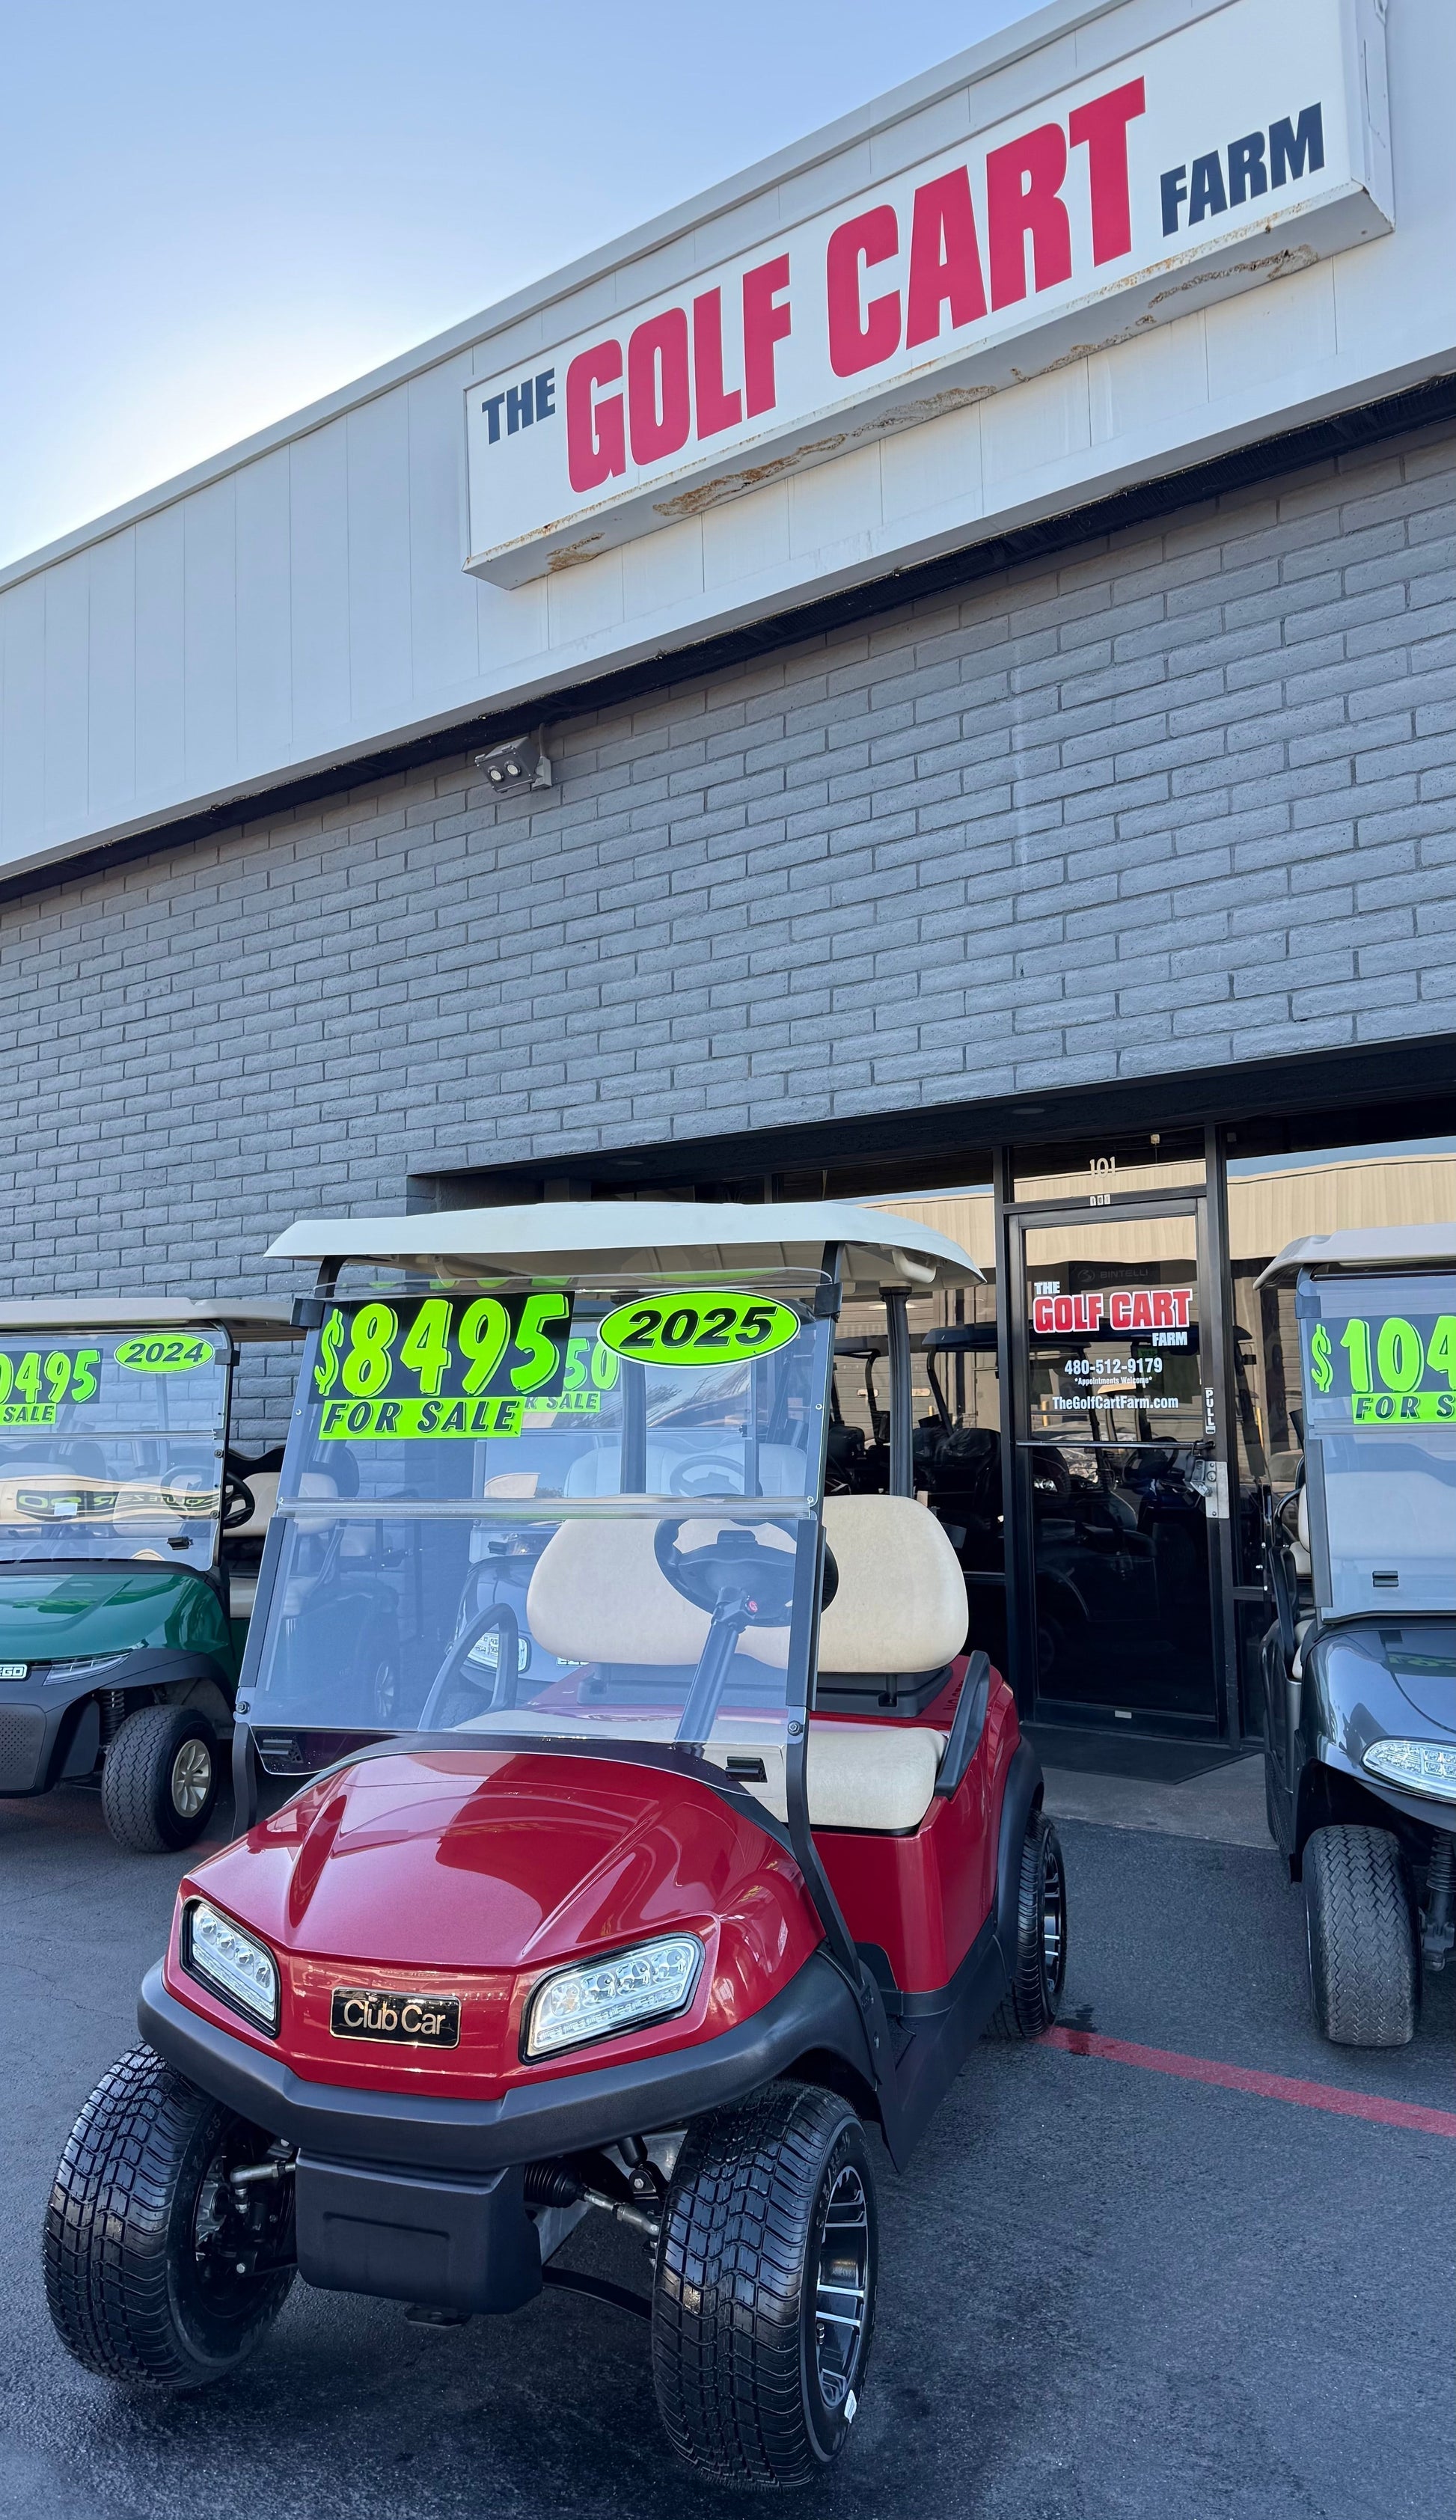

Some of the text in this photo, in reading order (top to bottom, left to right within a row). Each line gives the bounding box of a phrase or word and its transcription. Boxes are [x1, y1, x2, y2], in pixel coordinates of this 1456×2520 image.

[482, 76, 1325, 493] THE GOLF CART FARM
[1089, 1156, 1116, 1178] 101
[1100, 1269, 1148, 1279] BINTELLI
[1034, 1282, 1060, 1294] THE
[1033, 1288, 1193, 1333] GOLF CART
[620, 1306, 777, 1349] 2025
[314, 1294, 569, 1398] $8495
[1152, 1332, 1187, 1346] FARM
[124, 1342, 204, 1363] 2024
[563, 1338, 620, 1390] 50
[1064, 1357, 1163, 1374] 480-512-9179
[546, 1393, 599, 1410] SALE
[1053, 1395, 1178, 1410] TheGolfCartFarm.com
[1205, 1390, 1215, 1426] PULL
[1356, 1396, 1420, 1420] FOR
[3, 1406, 54, 1422] SALE
[322, 1401, 521, 1434] FOR SALE
[0, 1667, 23, 1676] GO
[344, 1999, 445, 2035] Club Car
